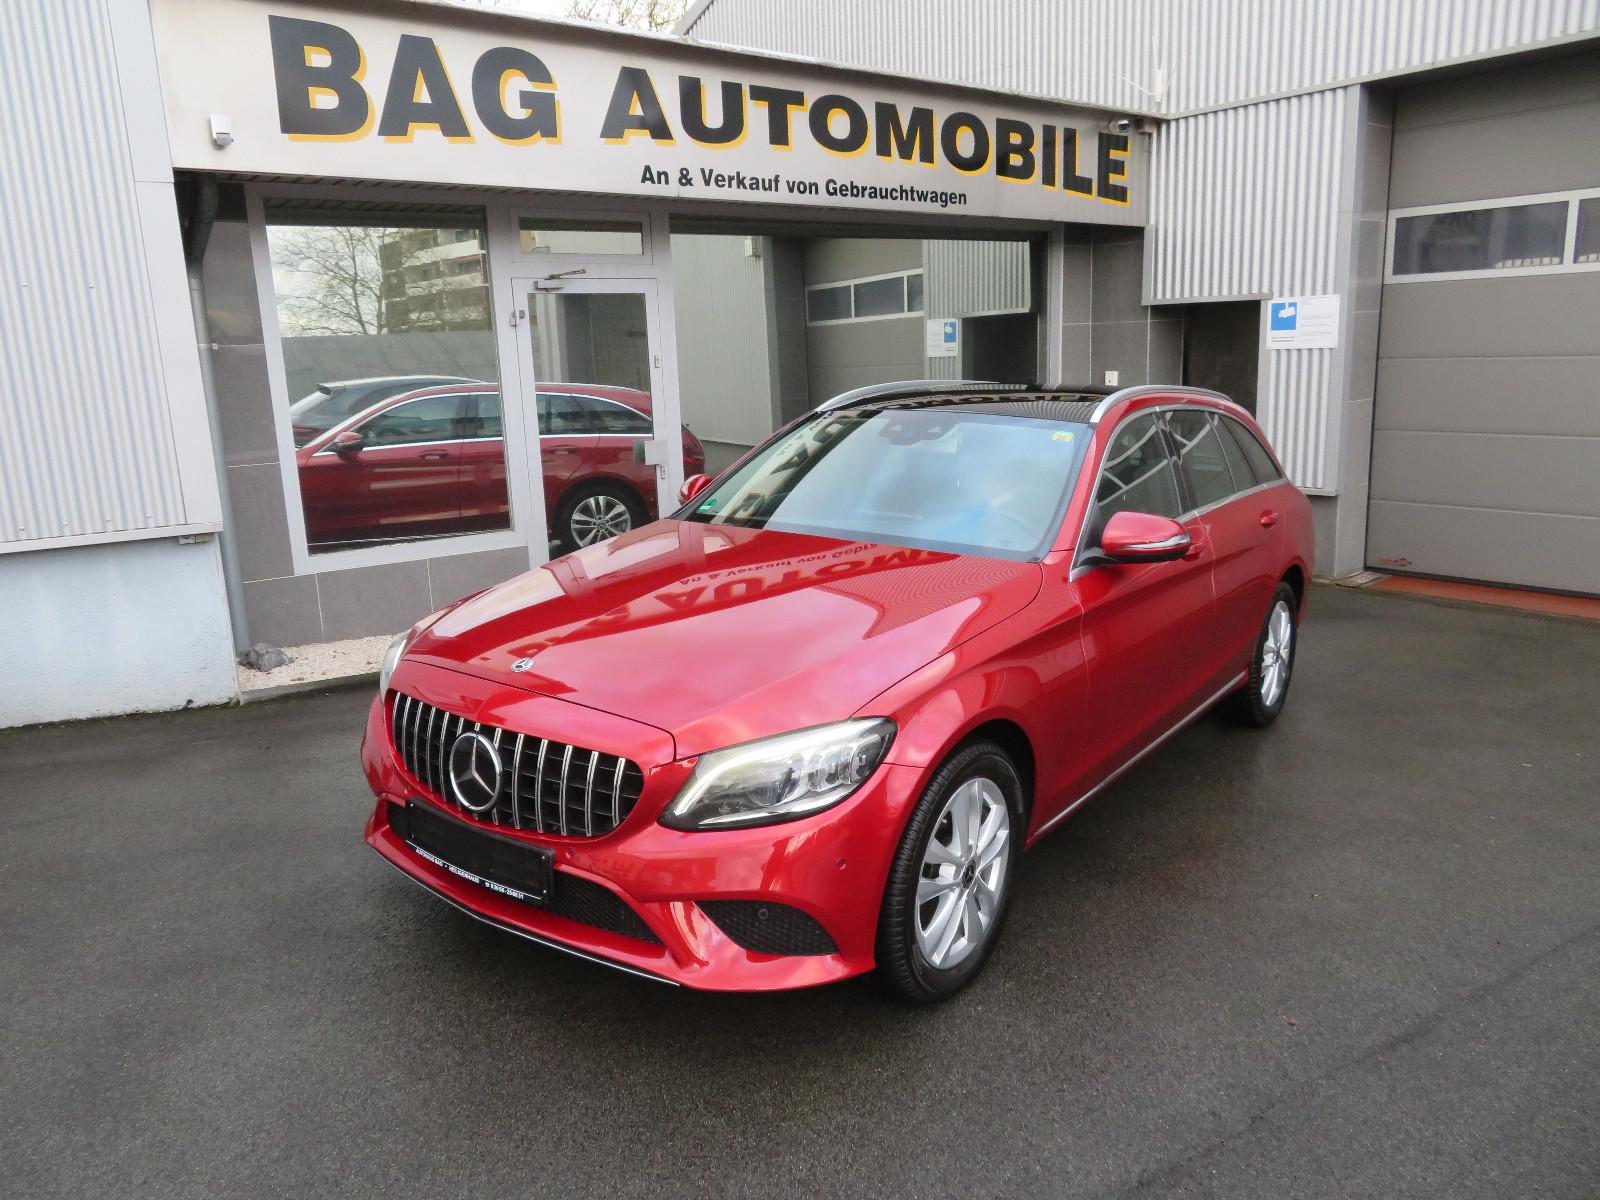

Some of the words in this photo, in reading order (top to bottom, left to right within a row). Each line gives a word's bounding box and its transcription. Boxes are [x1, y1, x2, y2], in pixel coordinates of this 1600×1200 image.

[268, 14, 563, 147] BAG
[599, 65, 1130, 208] AUTOMOBILE
[640, 165, 670, 185] An
[677, 167, 694, 187] &
[699, 167, 781, 193] Verkauf
[785, 179, 819, 196] von
[825, 178, 967, 208] Gebrauchtwagen
